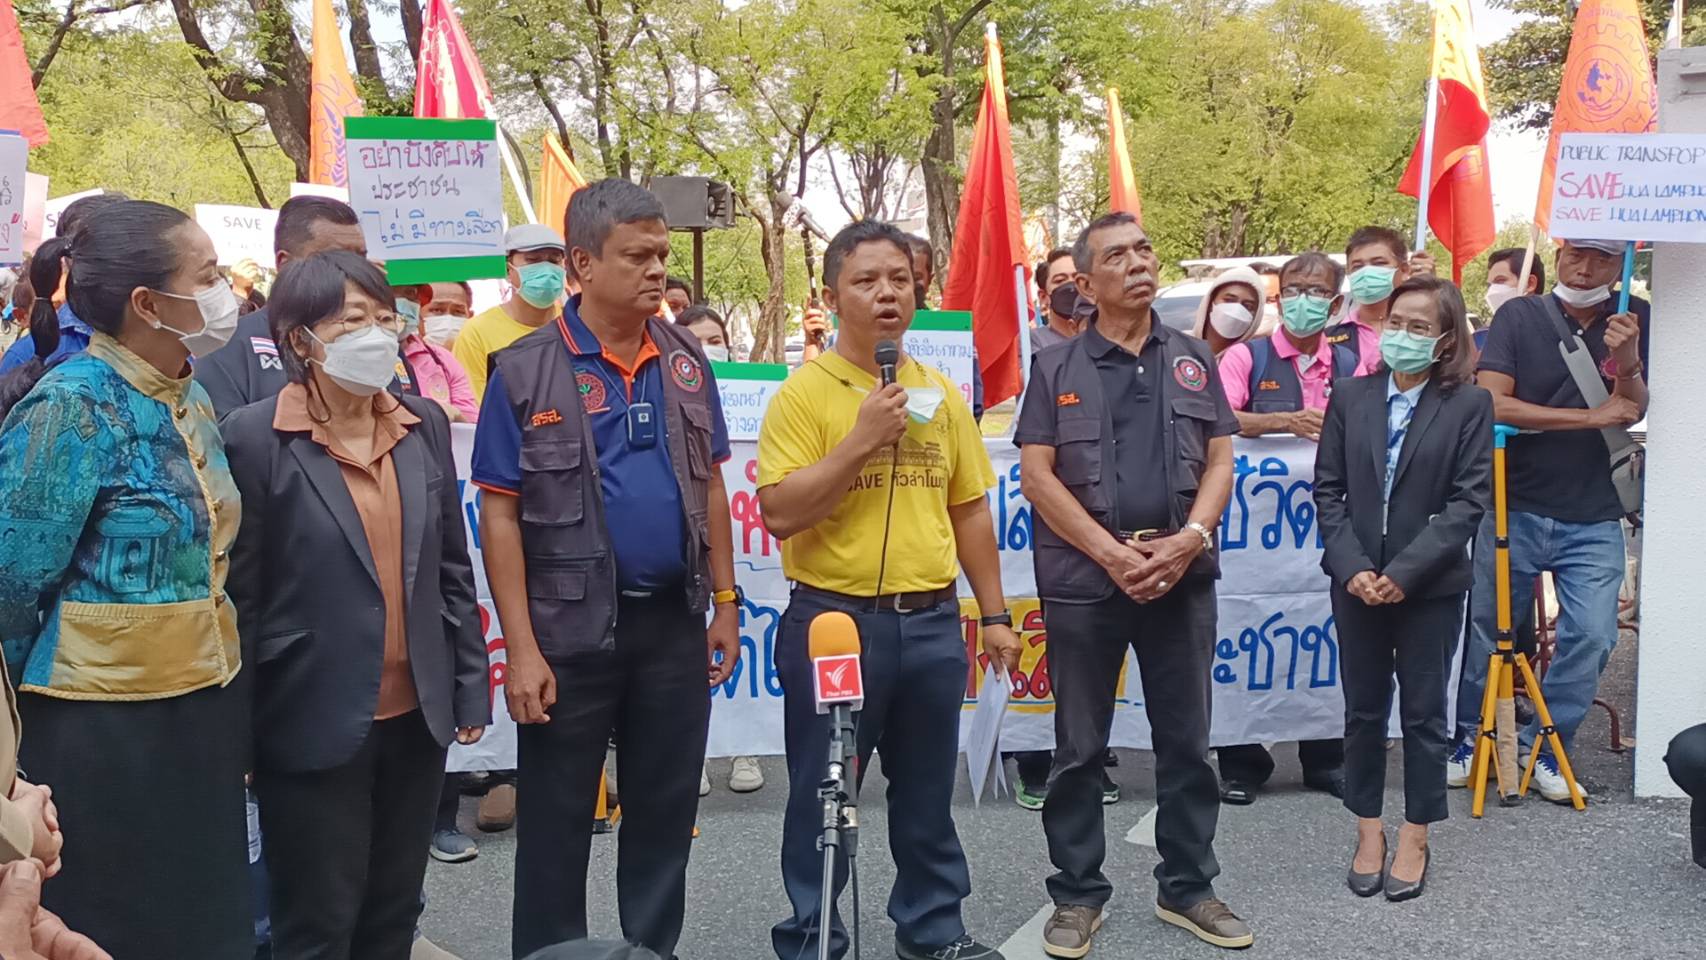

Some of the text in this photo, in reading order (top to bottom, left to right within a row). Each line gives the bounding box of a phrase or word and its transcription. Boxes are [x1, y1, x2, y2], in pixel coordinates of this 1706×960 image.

[371, 173, 461, 200] ประชาชน
[1558, 172, 1623, 200] SAVE
[223, 215, 263, 231] SAVE
[1555, 206, 1603, 222] SAVE
[847, 472, 884, 492] AVE
